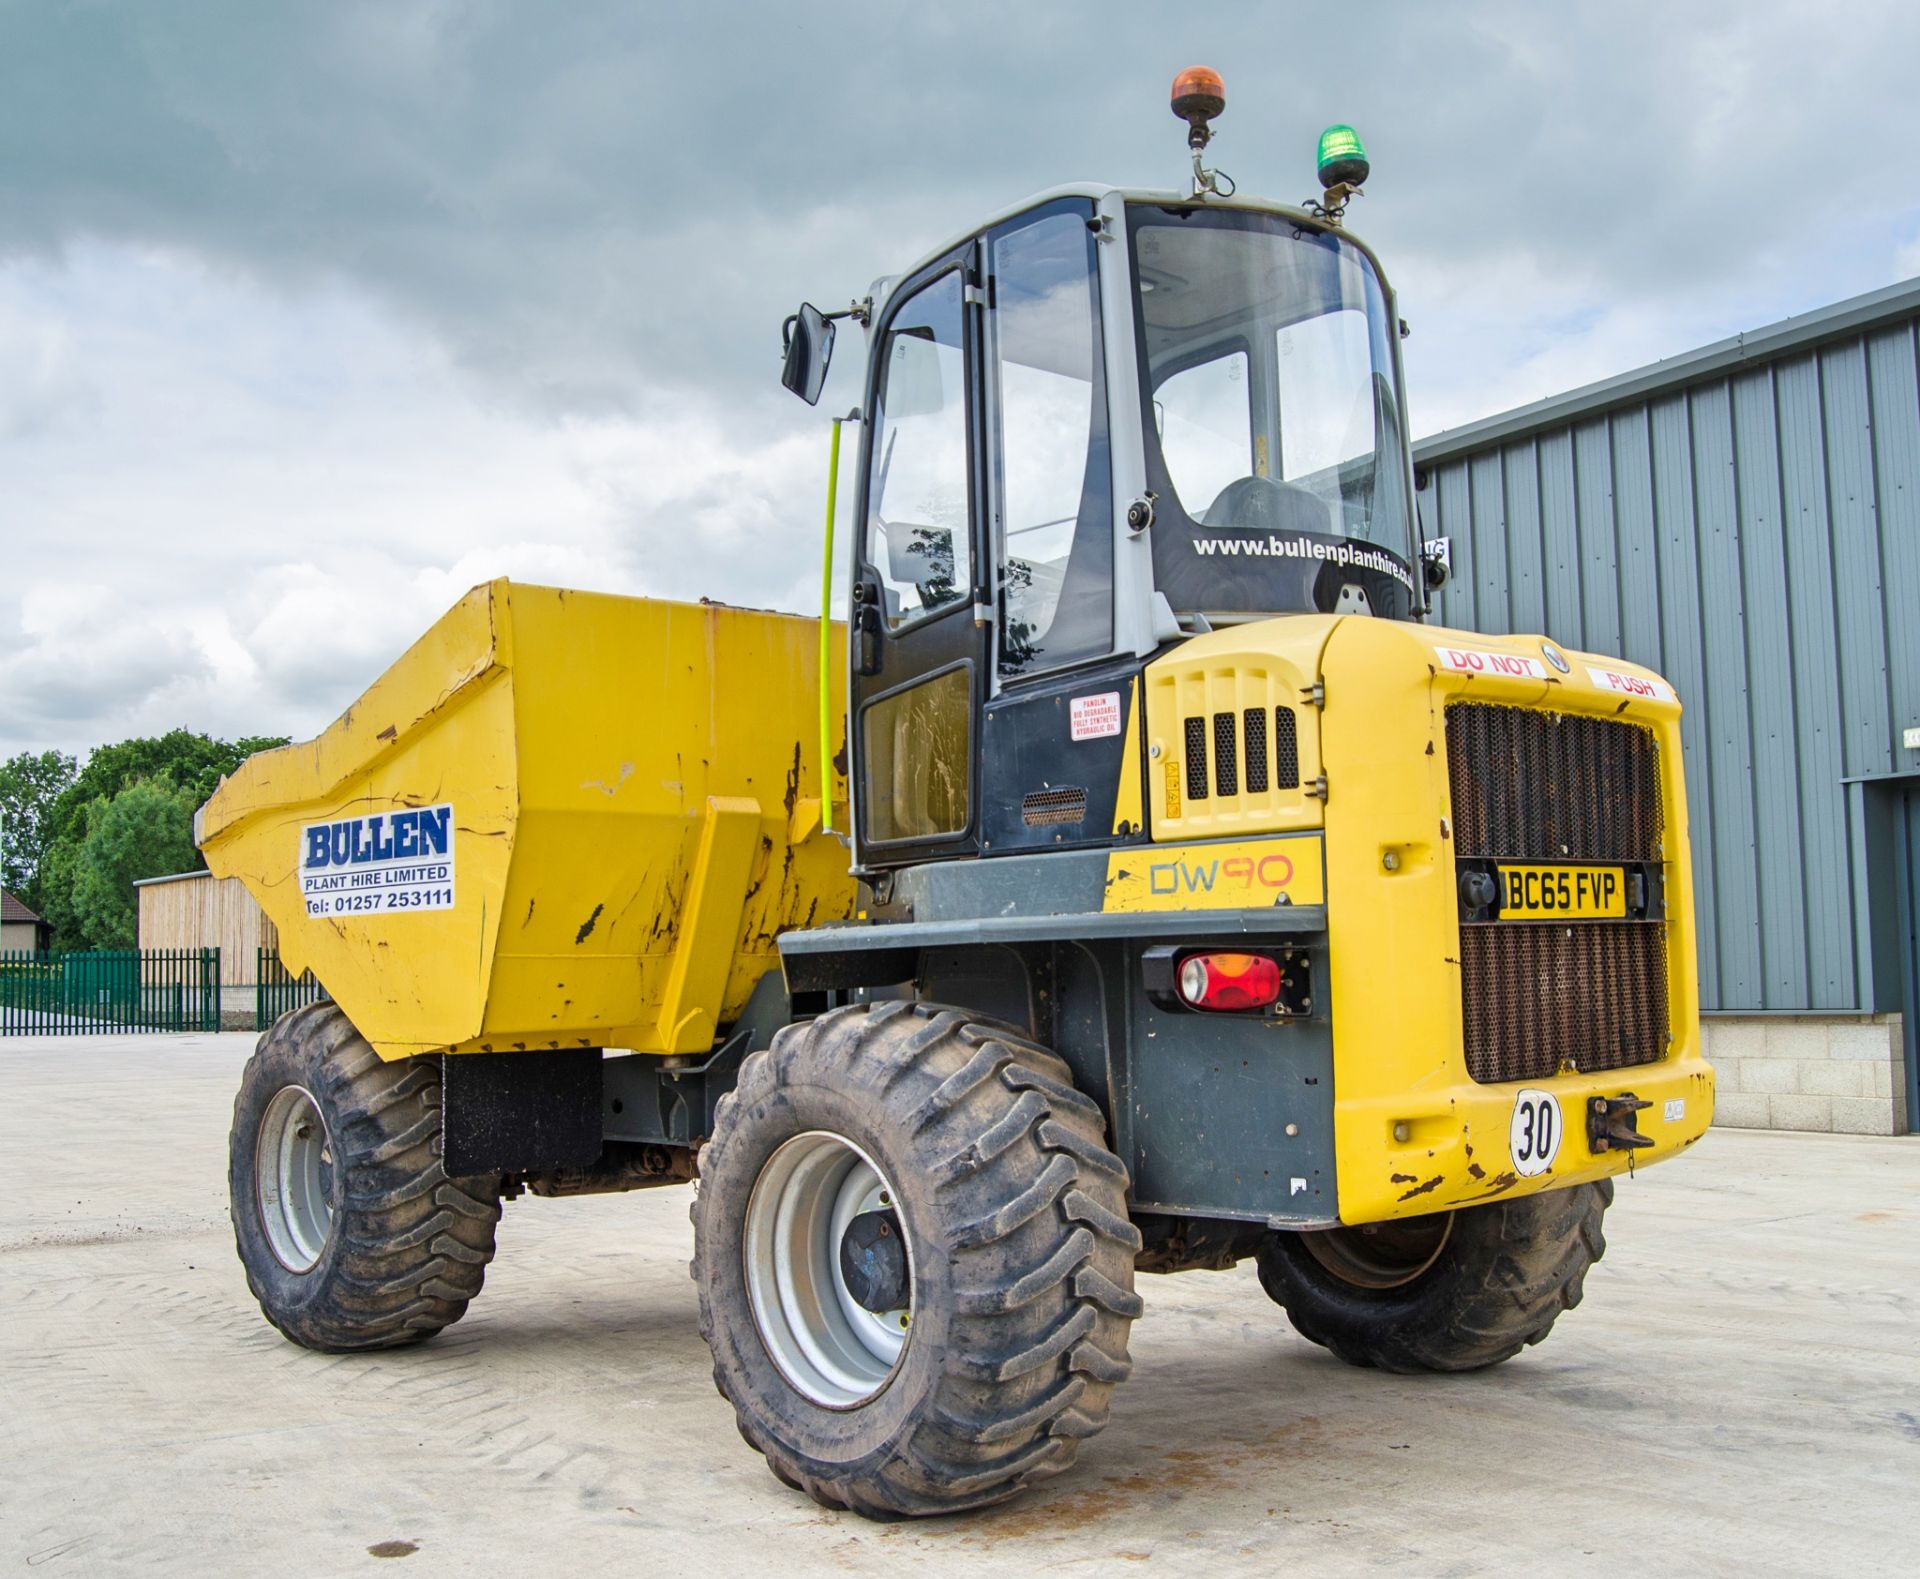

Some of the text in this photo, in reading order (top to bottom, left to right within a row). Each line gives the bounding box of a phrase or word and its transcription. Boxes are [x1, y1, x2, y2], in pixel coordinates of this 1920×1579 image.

[1448, 651, 1533, 676] DO NOT
[1606, 673, 1656, 697] PUSH
[1073, 714, 1117, 728] FULLY SYNTHETIC
[1084, 706, 1116, 717] DEGRADABLE
[1076, 725, 1105, 735] HYDRAULIC
[305, 807, 450, 869] BULLEN
[305, 866, 448, 891] PLANT HIRE LIMITED
[1150, 854, 1294, 895] DW90
[307, 889, 452, 914] Tel: 01257 253111
[1509, 871, 1615, 910] BC65 FVP
[1518, 1100, 1553, 1162] 30
